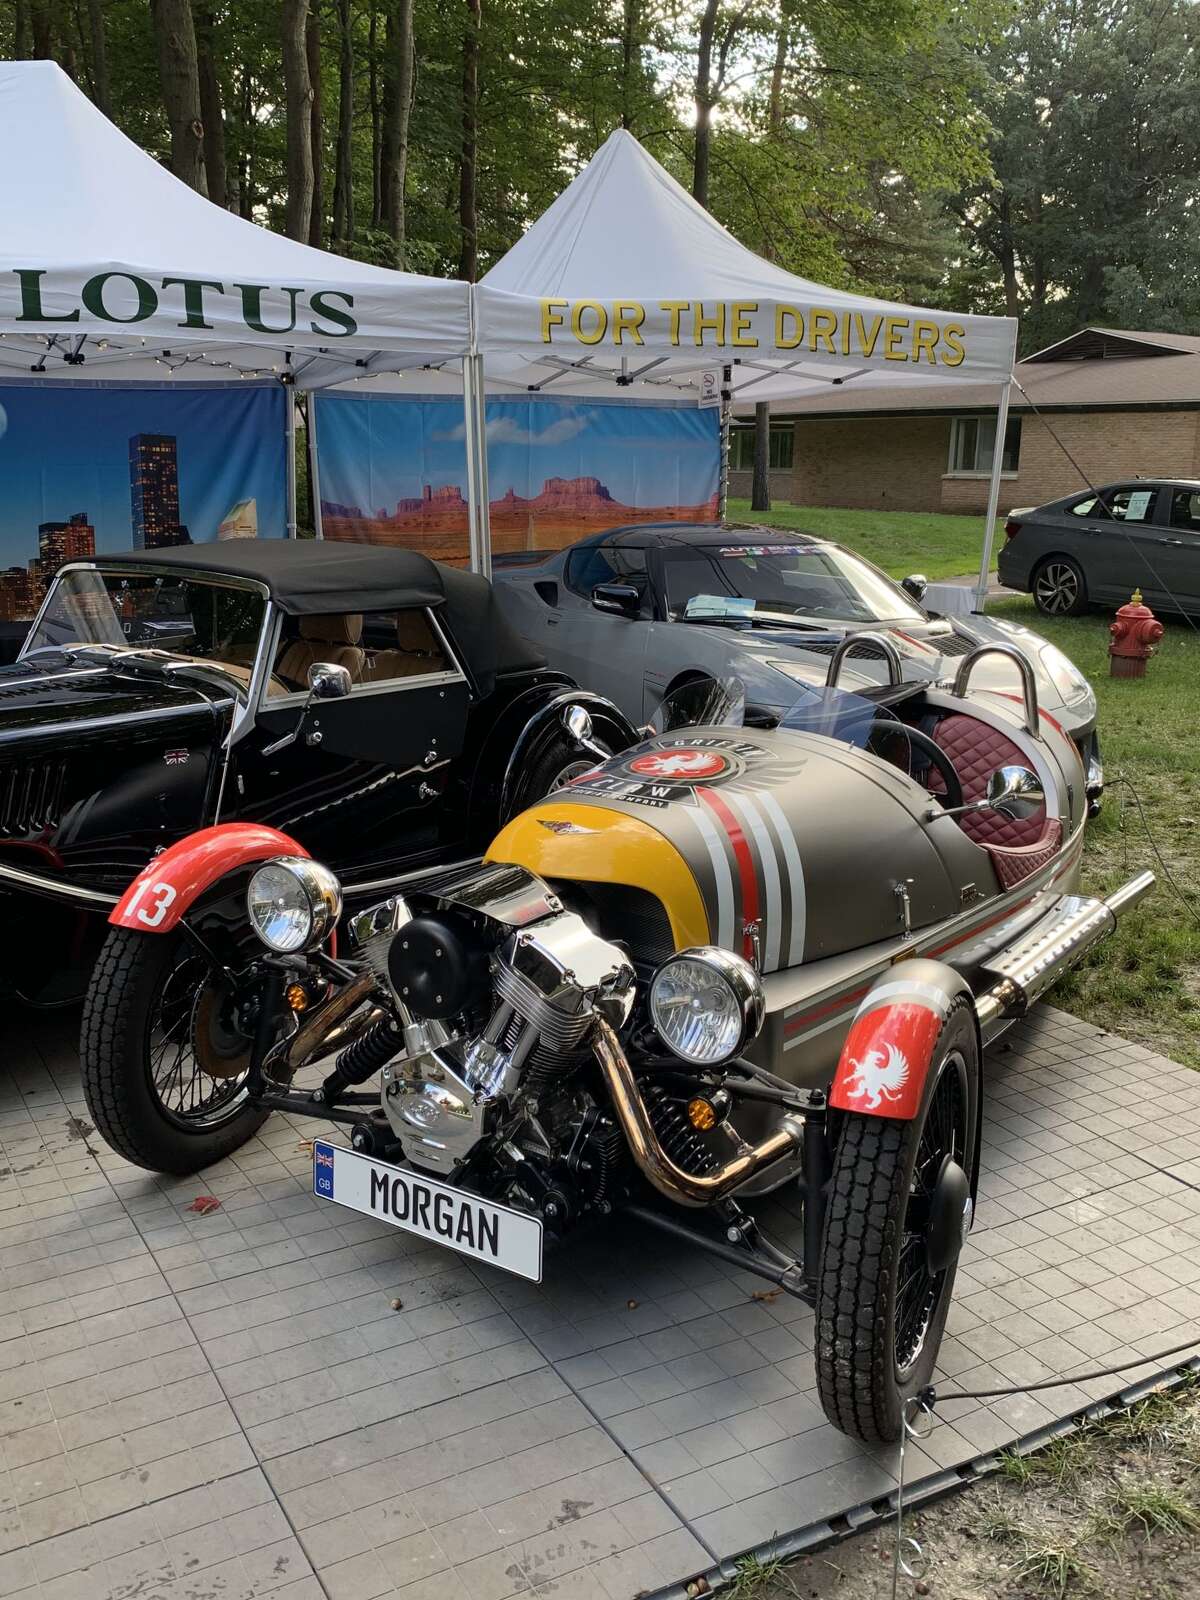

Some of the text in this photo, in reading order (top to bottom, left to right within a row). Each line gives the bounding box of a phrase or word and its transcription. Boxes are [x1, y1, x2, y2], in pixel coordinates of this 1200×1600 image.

[12, 268, 358, 337] LOTUS
[539, 299, 967, 367] FOR THE DRIVERS
[591, 779, 671, 798] CLAW
[123, 878, 177, 927] 13
[318, 1176, 331, 1191] GB
[369, 1168, 499, 1257] MORGAN
